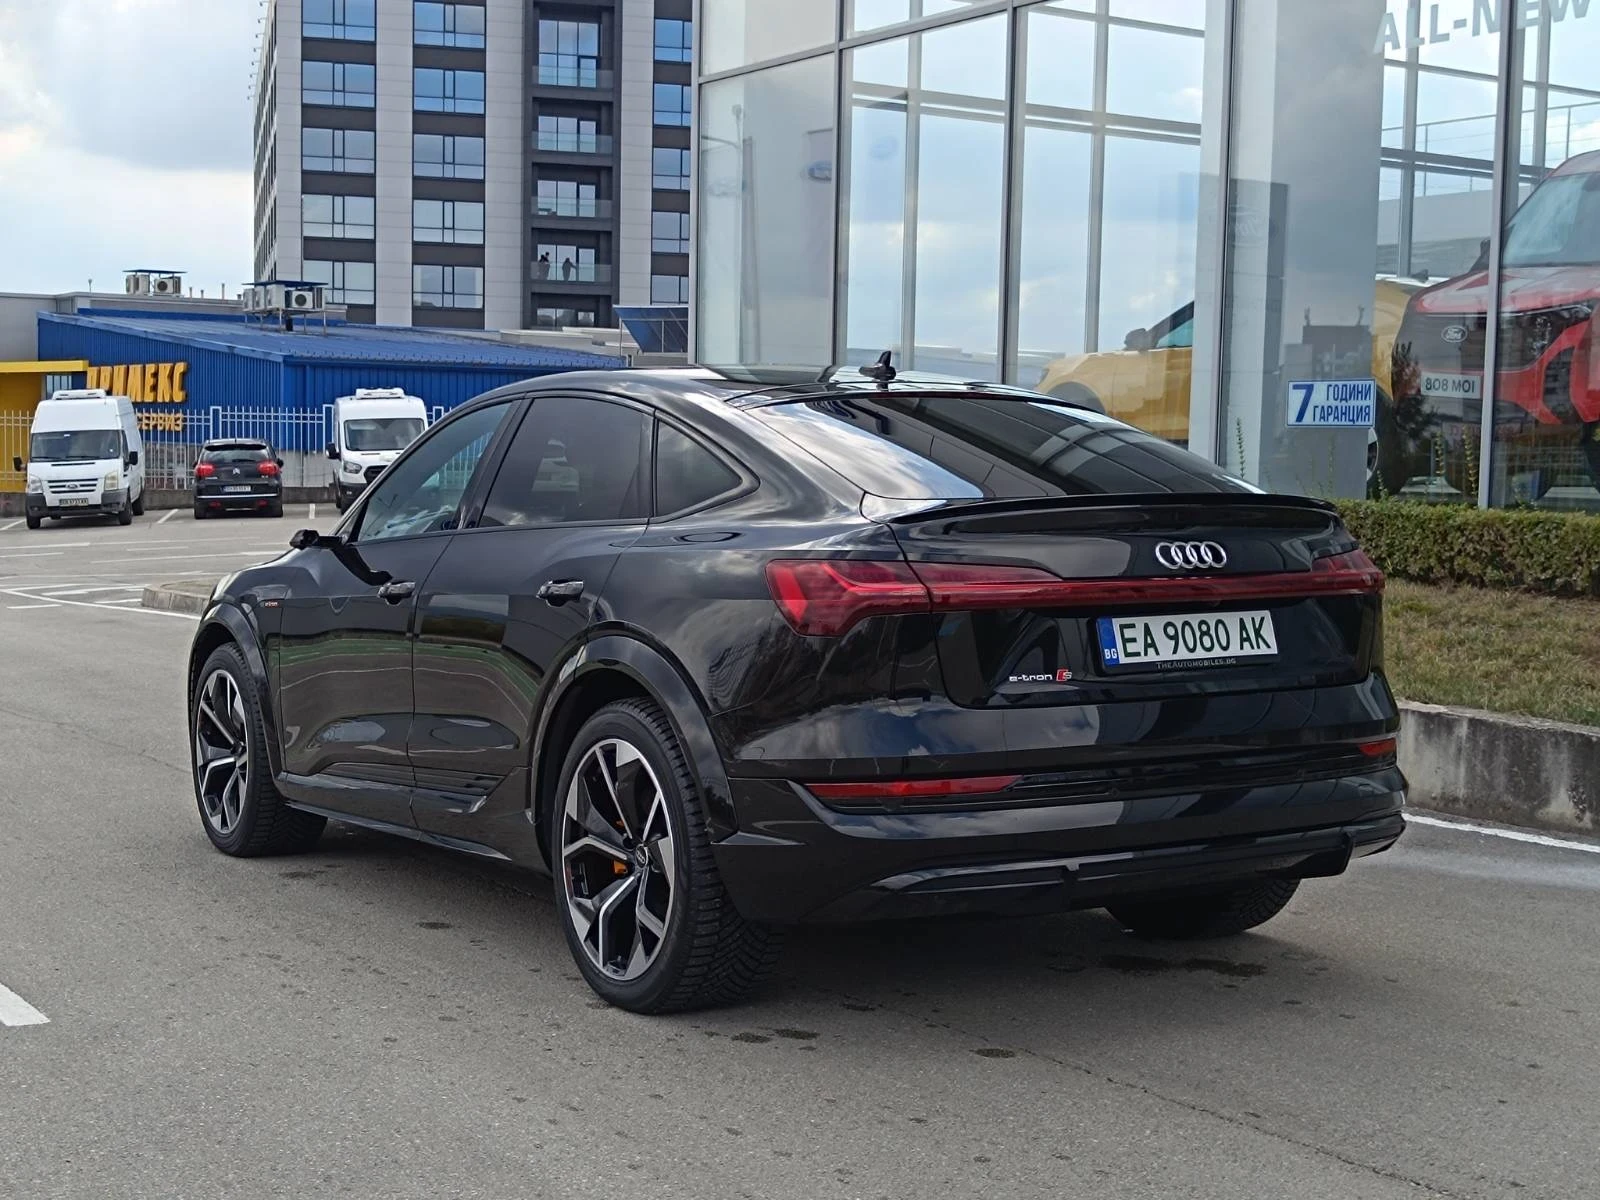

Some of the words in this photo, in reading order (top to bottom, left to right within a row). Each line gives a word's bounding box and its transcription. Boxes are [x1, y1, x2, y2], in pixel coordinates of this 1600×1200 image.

[1372, 0, 1591, 54] ALL-NEW
[1292, 383, 1314, 423] 7
[1326, 383, 1372, 403] ГОДИНИ
[1313, 404, 1371, 425] ГАРАНЦИЯ
[1118, 622, 1160, 658] EA
[1163, 618, 1230, 655] 9080
[1238, 616, 1272, 650] AK
[1105, 648, 1118, 660] BG
[1009, 674, 1053, 682] e-tron
